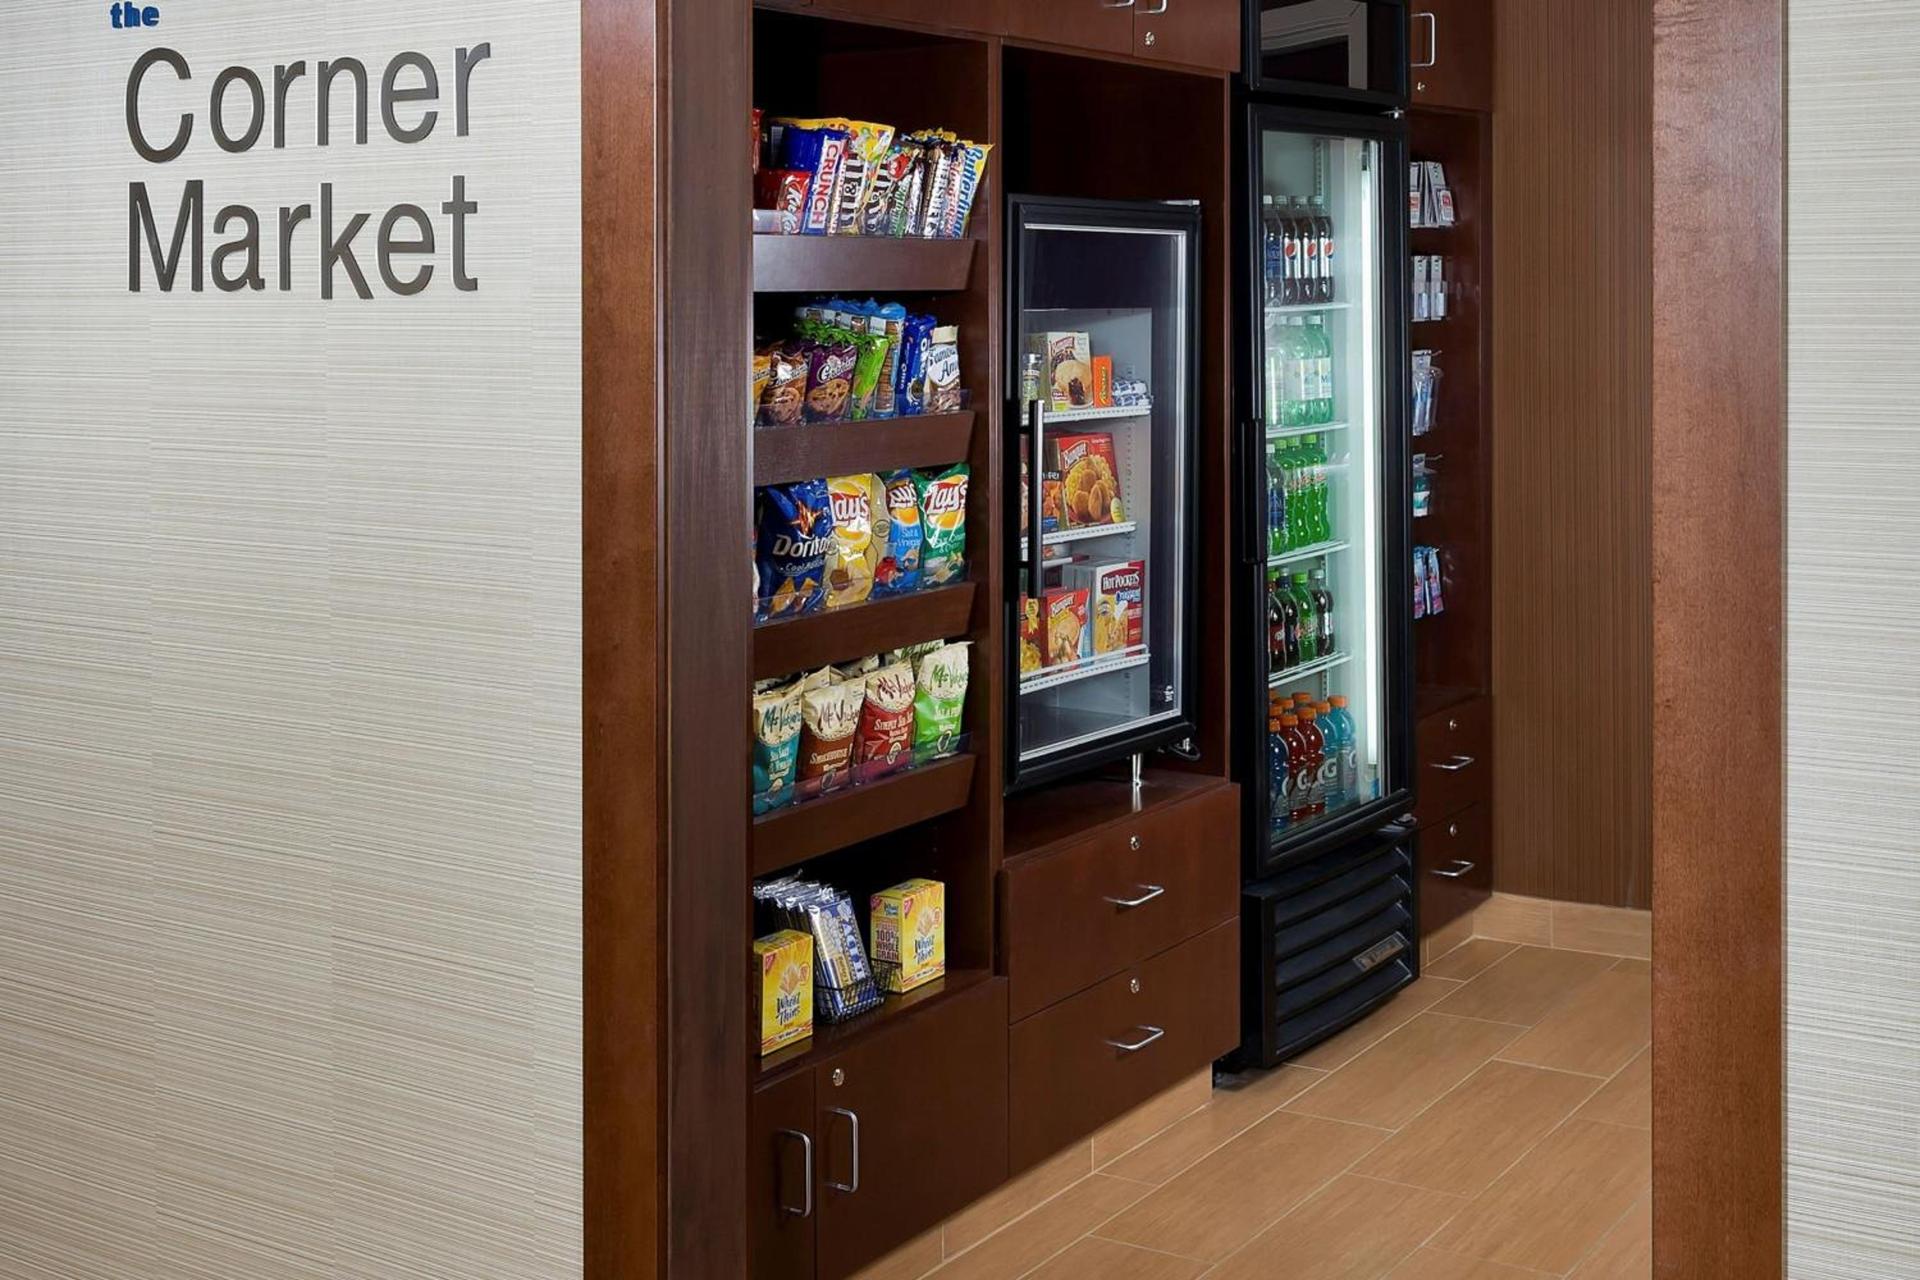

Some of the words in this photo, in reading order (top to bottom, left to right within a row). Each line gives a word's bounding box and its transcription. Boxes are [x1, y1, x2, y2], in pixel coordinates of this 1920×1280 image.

[110, 1, 160, 29] the
[125, 42, 491, 163] Corner
[811, 143, 838, 225] CRUNCH
[954, 145, 983, 239] Butterfinge
[128, 175, 478, 300] Market
[772, 534, 838, 557] Dorito
